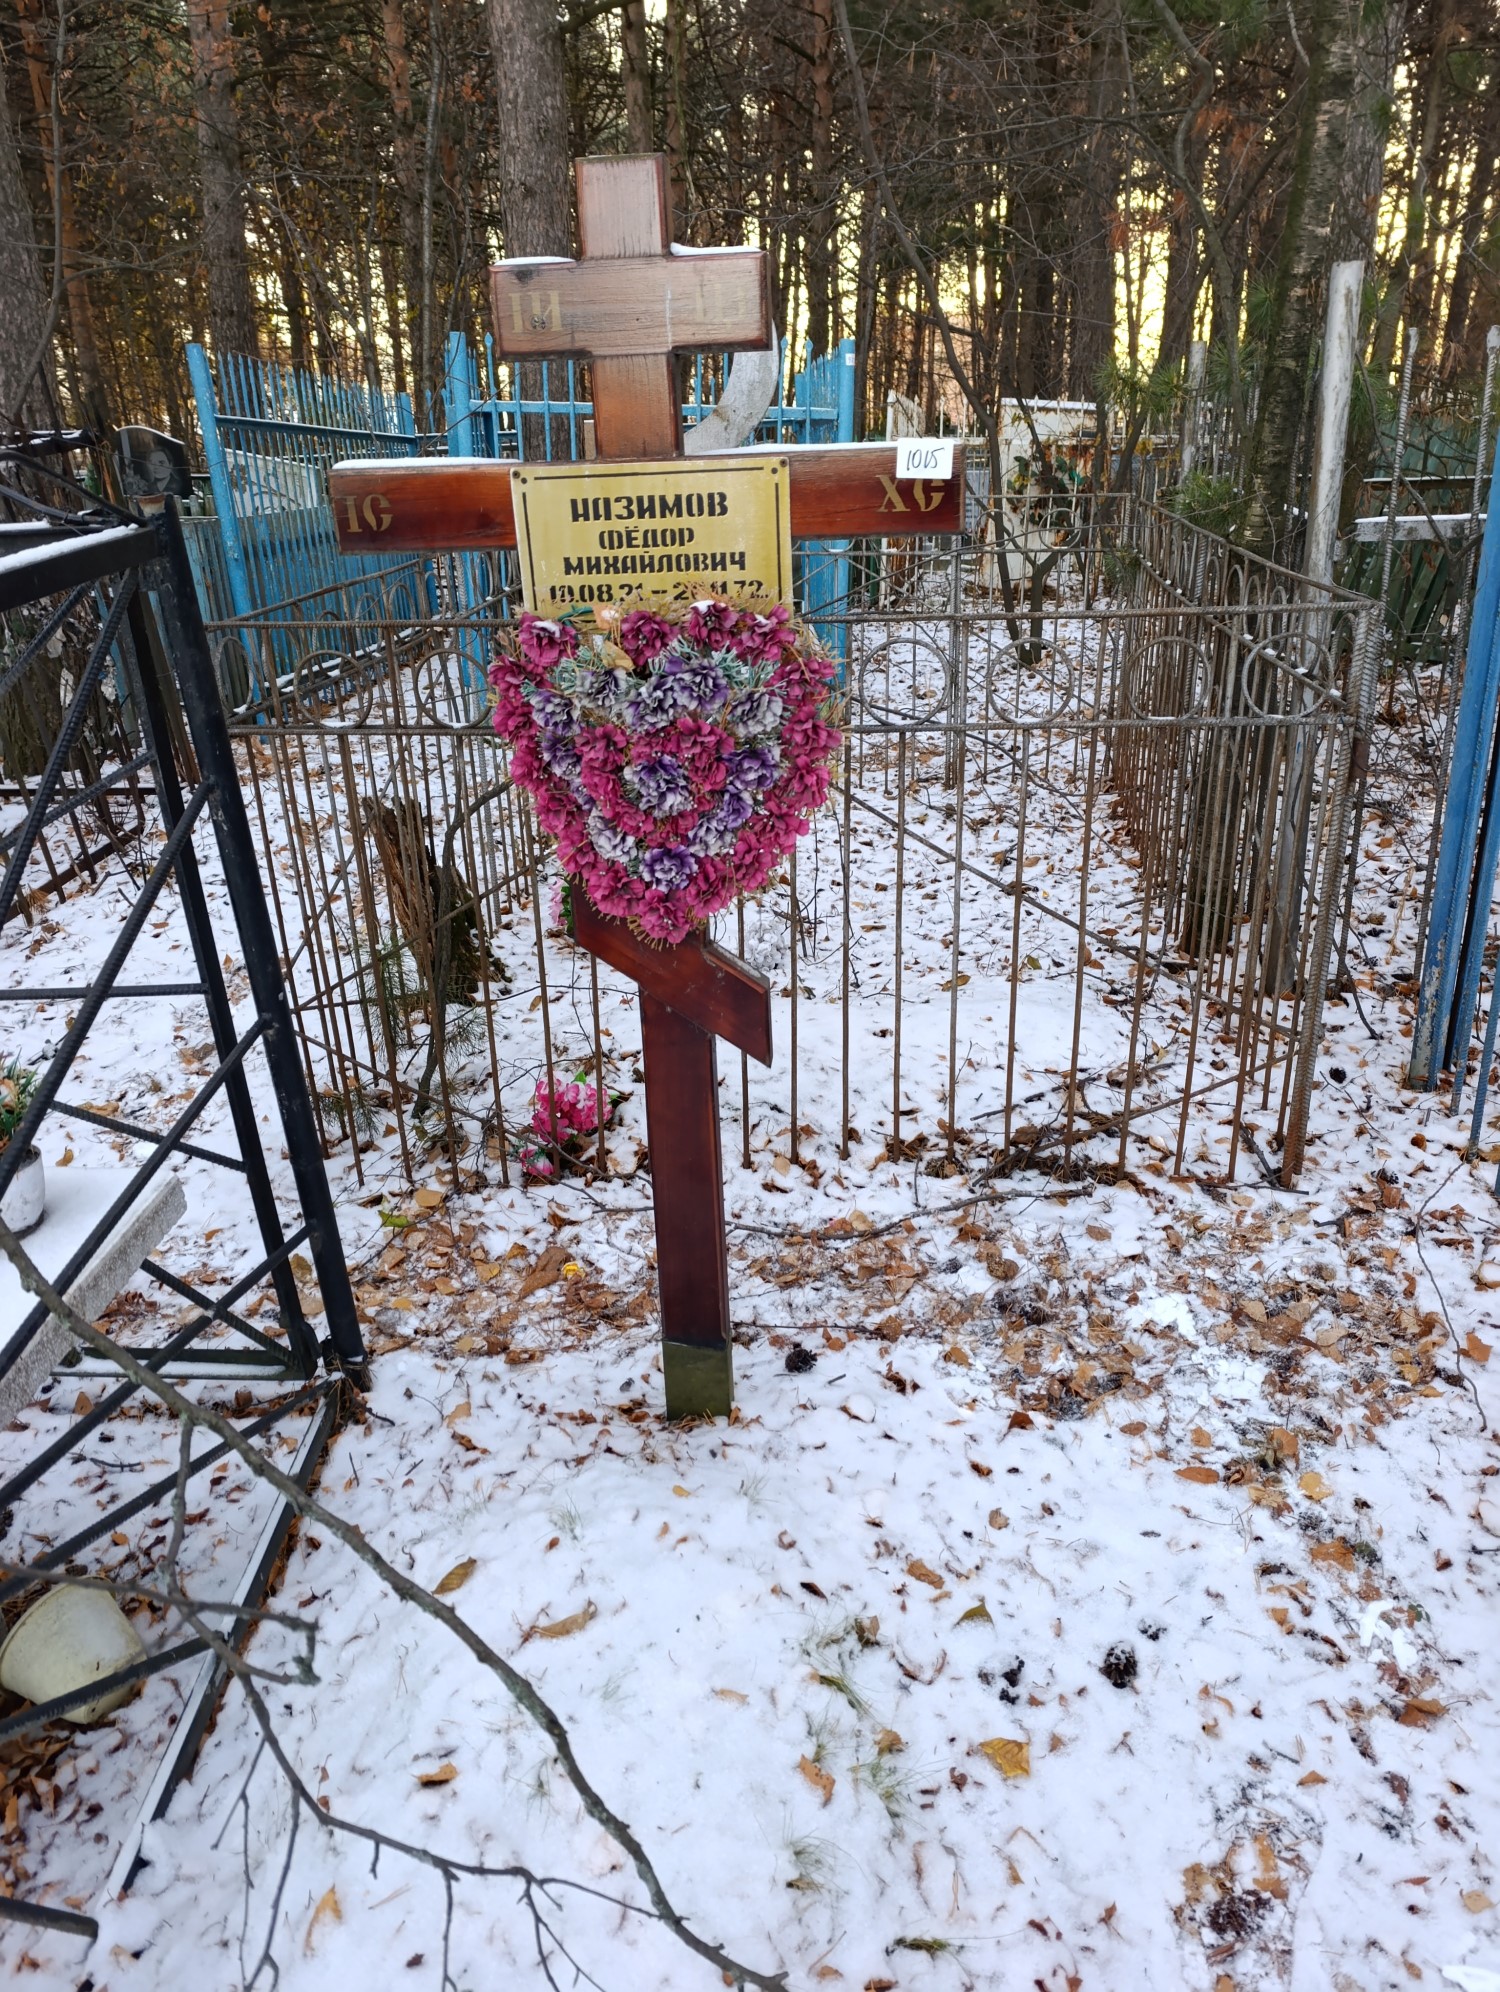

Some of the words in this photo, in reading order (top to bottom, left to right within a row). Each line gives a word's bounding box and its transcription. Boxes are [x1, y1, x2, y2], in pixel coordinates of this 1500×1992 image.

[906, 447, 945, 471] 1015
[570, 491, 729, 523] НАЗИМОВ
[598, 525, 695, 551] ФЁДОР
[563, 551, 747, 576] МИХАЙЛОВИЧ
[549, 583, 643, 602] 10.0821
